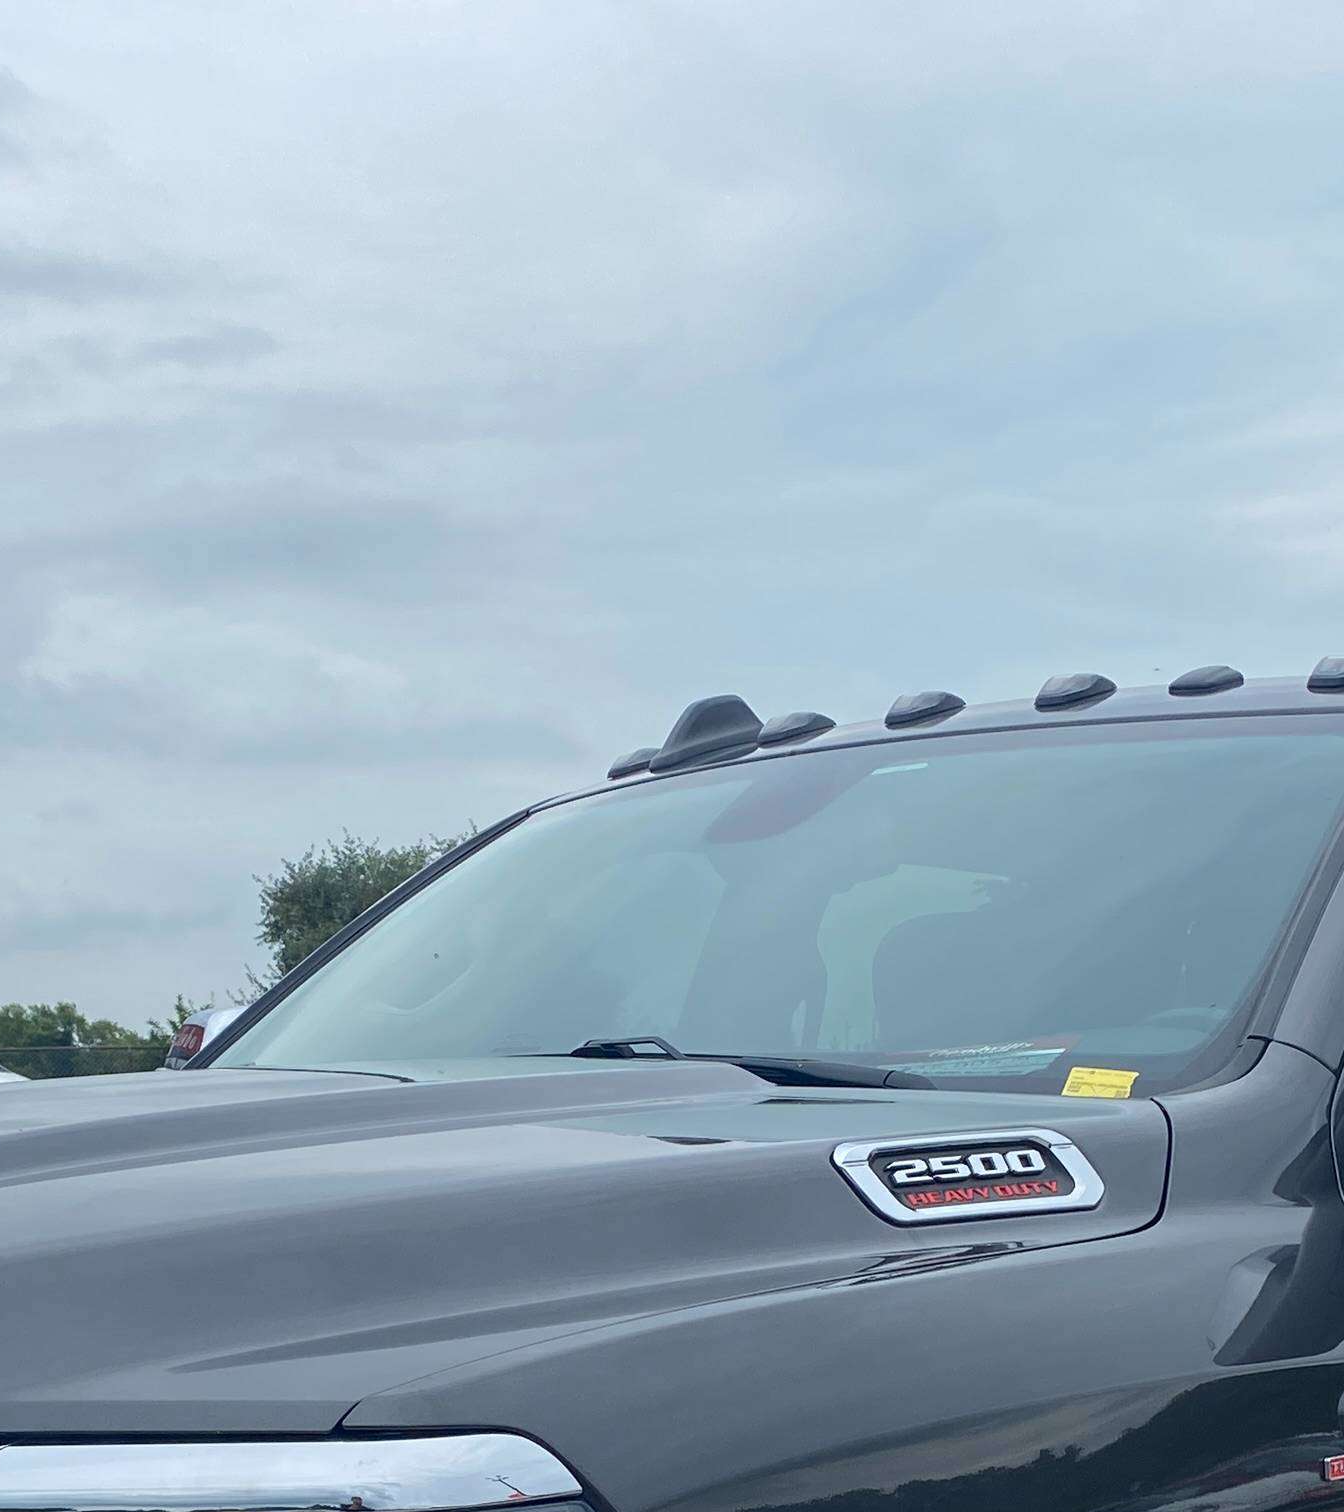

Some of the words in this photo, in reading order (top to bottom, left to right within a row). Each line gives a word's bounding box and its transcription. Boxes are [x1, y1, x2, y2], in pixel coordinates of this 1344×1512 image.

[887, 1149, 1046, 1187] 2500
[907, 1187, 990, 1206] HEAVY
[993, 1180, 1058, 1198] DUTY
